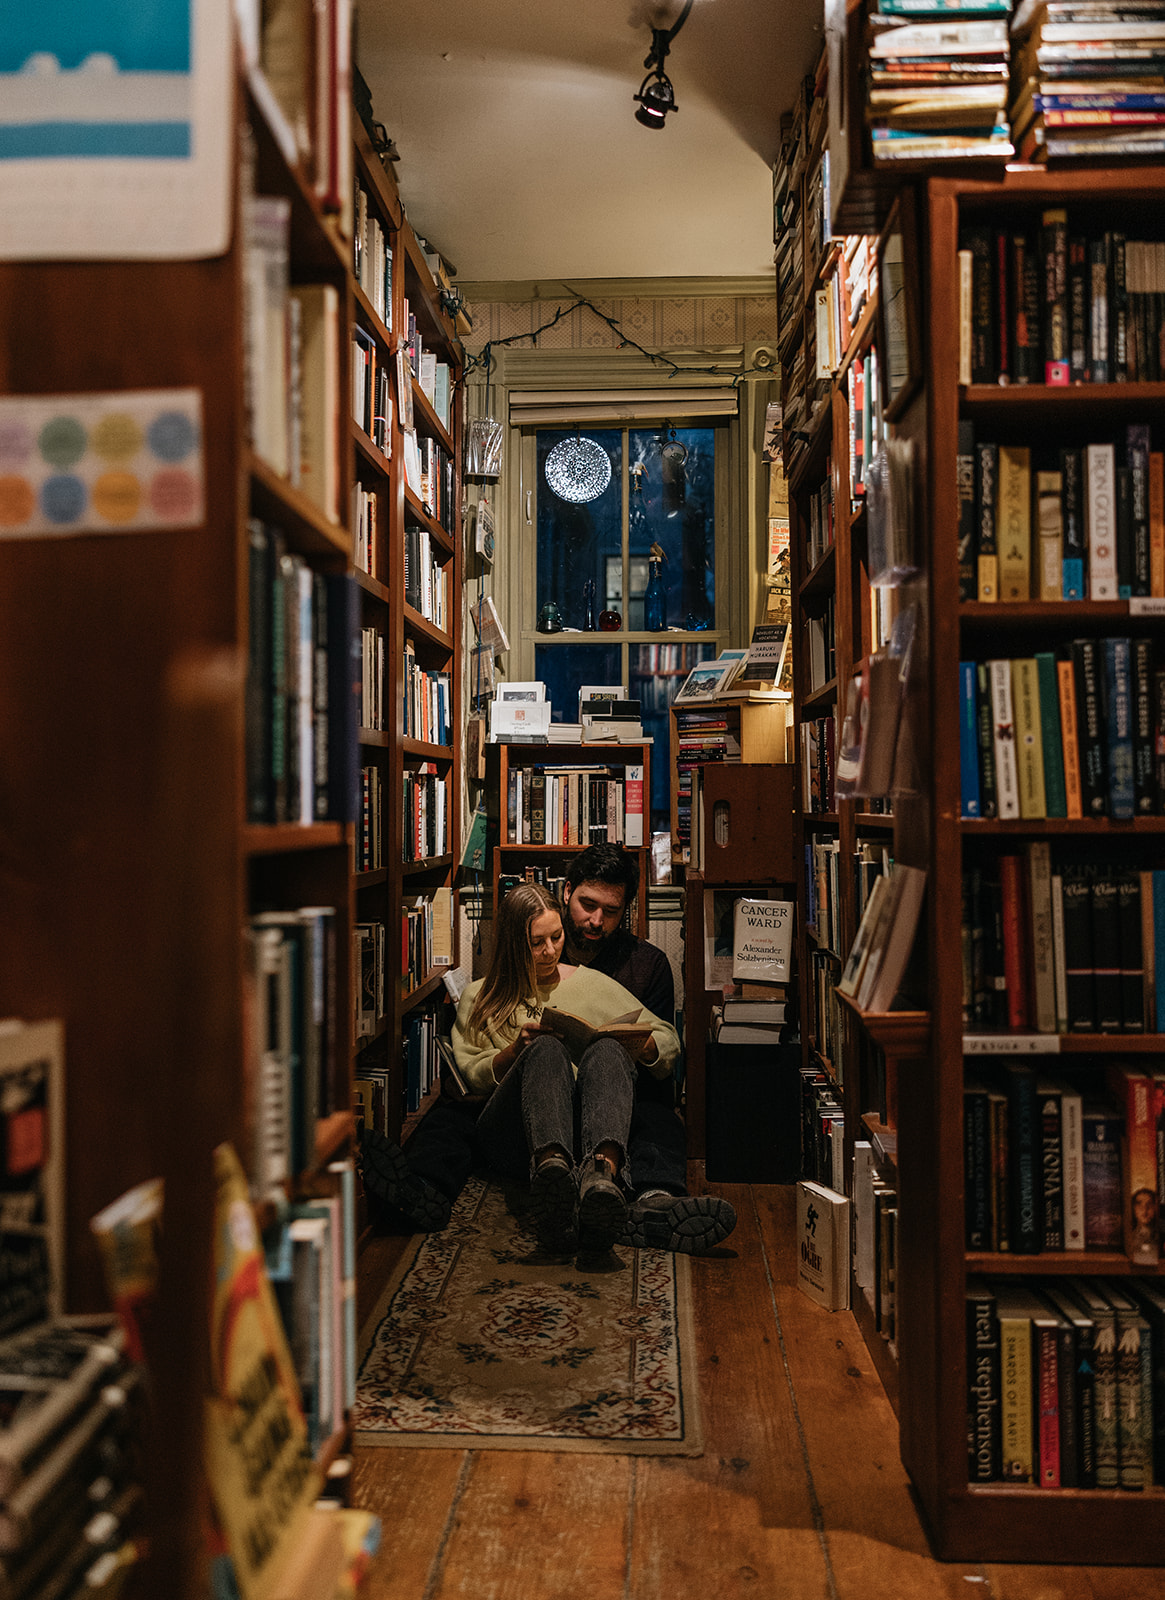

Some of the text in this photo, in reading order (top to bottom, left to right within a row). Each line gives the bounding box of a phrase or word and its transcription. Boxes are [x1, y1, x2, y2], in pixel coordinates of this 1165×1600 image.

[1094, 453, 1109, 492] IRON
[1094, 494, 1110, 538] GOLD
[1083, 644, 1098, 738] WILLIAM GIBSON
[1115, 644, 1128, 738] WILLIAM GIBSON
[1138, 644, 1150, 738] WILLIAM GIBSON
[741, 905, 788, 918] CANCER
[747, 918, 782, 929] WARD
[742, 944, 782, 954] Alexander
[1068, 1156, 1078, 1216] TITUS GROAN
[801, 1241, 822, 1272] OGRE
[807, 1235, 816, 1252] THE
[970, 1304, 999, 1478] neal stephenson
[1006, 1336, 1017, 1448] SHARDS OF EARTH
